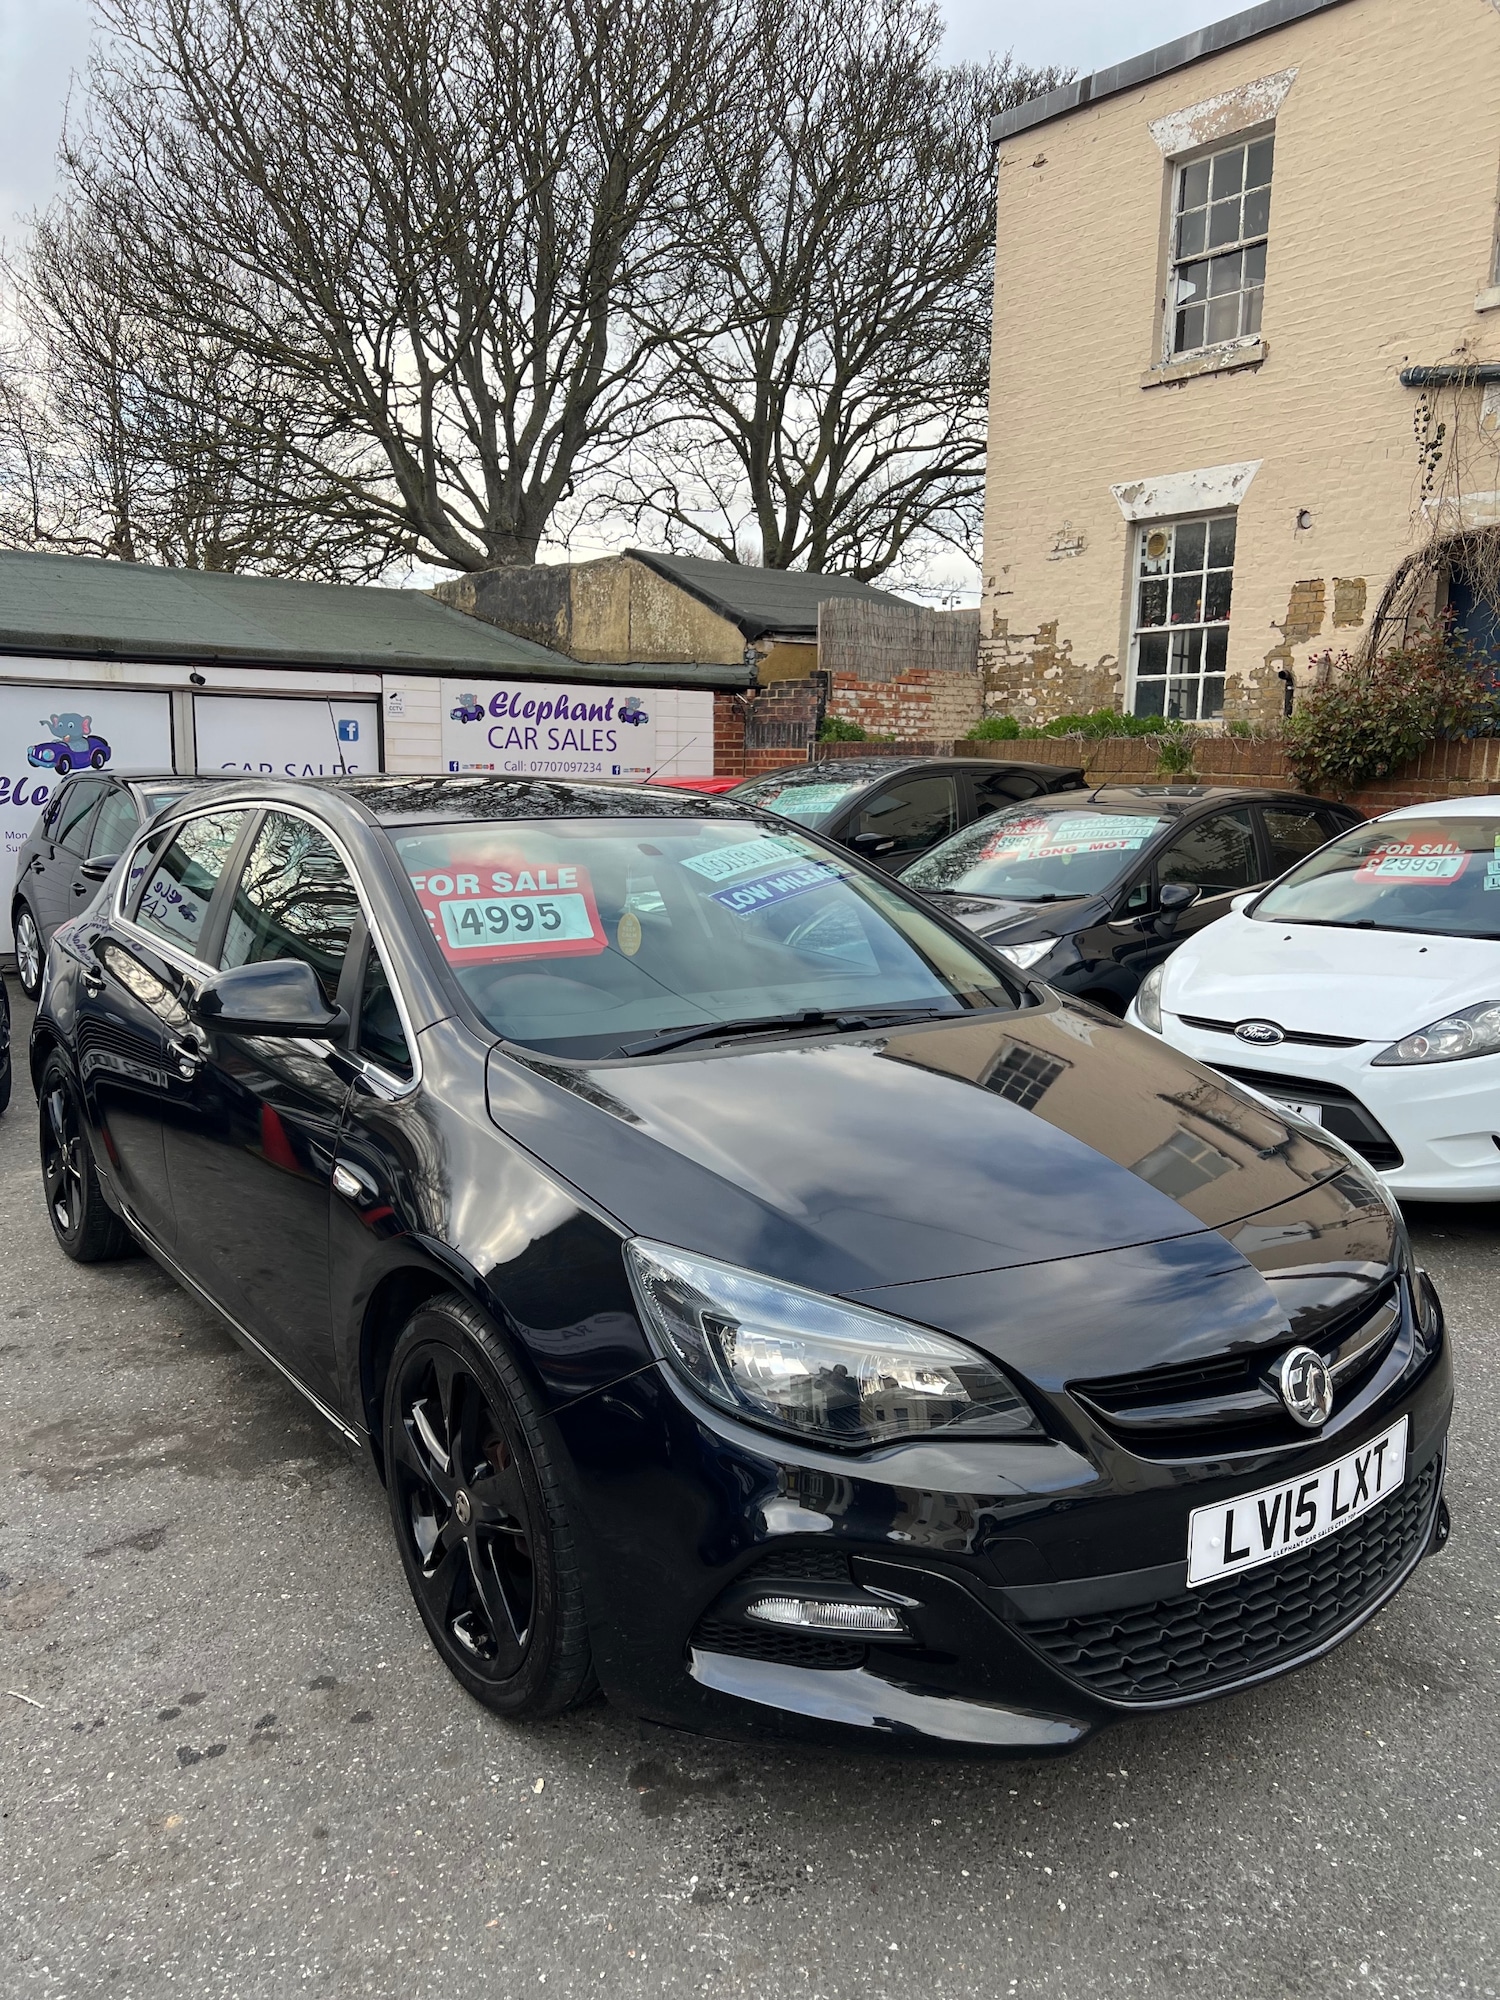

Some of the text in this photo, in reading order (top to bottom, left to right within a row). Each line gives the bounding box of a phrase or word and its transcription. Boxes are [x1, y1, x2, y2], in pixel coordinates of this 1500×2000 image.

[488, 691, 614, 726] Elephant
[487, 726, 617, 752] CAR SALES
[504, 760, 527, 772] Call:
[530, 761, 602, 773] 07707097234
[5, 831, 28, 839] Mon
[998, 836, 1031, 848] 3995
[1028, 840, 1130, 859] LONG MOT
[1375, 844, 1415, 854] FOR
[1363, 858, 1438, 872] £ 2995
[410, 867, 578, 897] FOR SALE
[719, 861, 851, 910] LOW MILEAGE
[461, 902, 562, 935] 4995
[1243, 1025, 1272, 1040] Ford
[1222, 1438, 1389, 1564] LV15 LXT
[1272, 1541, 1304, 1557] ELEPHANT
[1305, 1534, 1317, 1544] CAR
[1317, 1525, 1334, 1538] SALES
